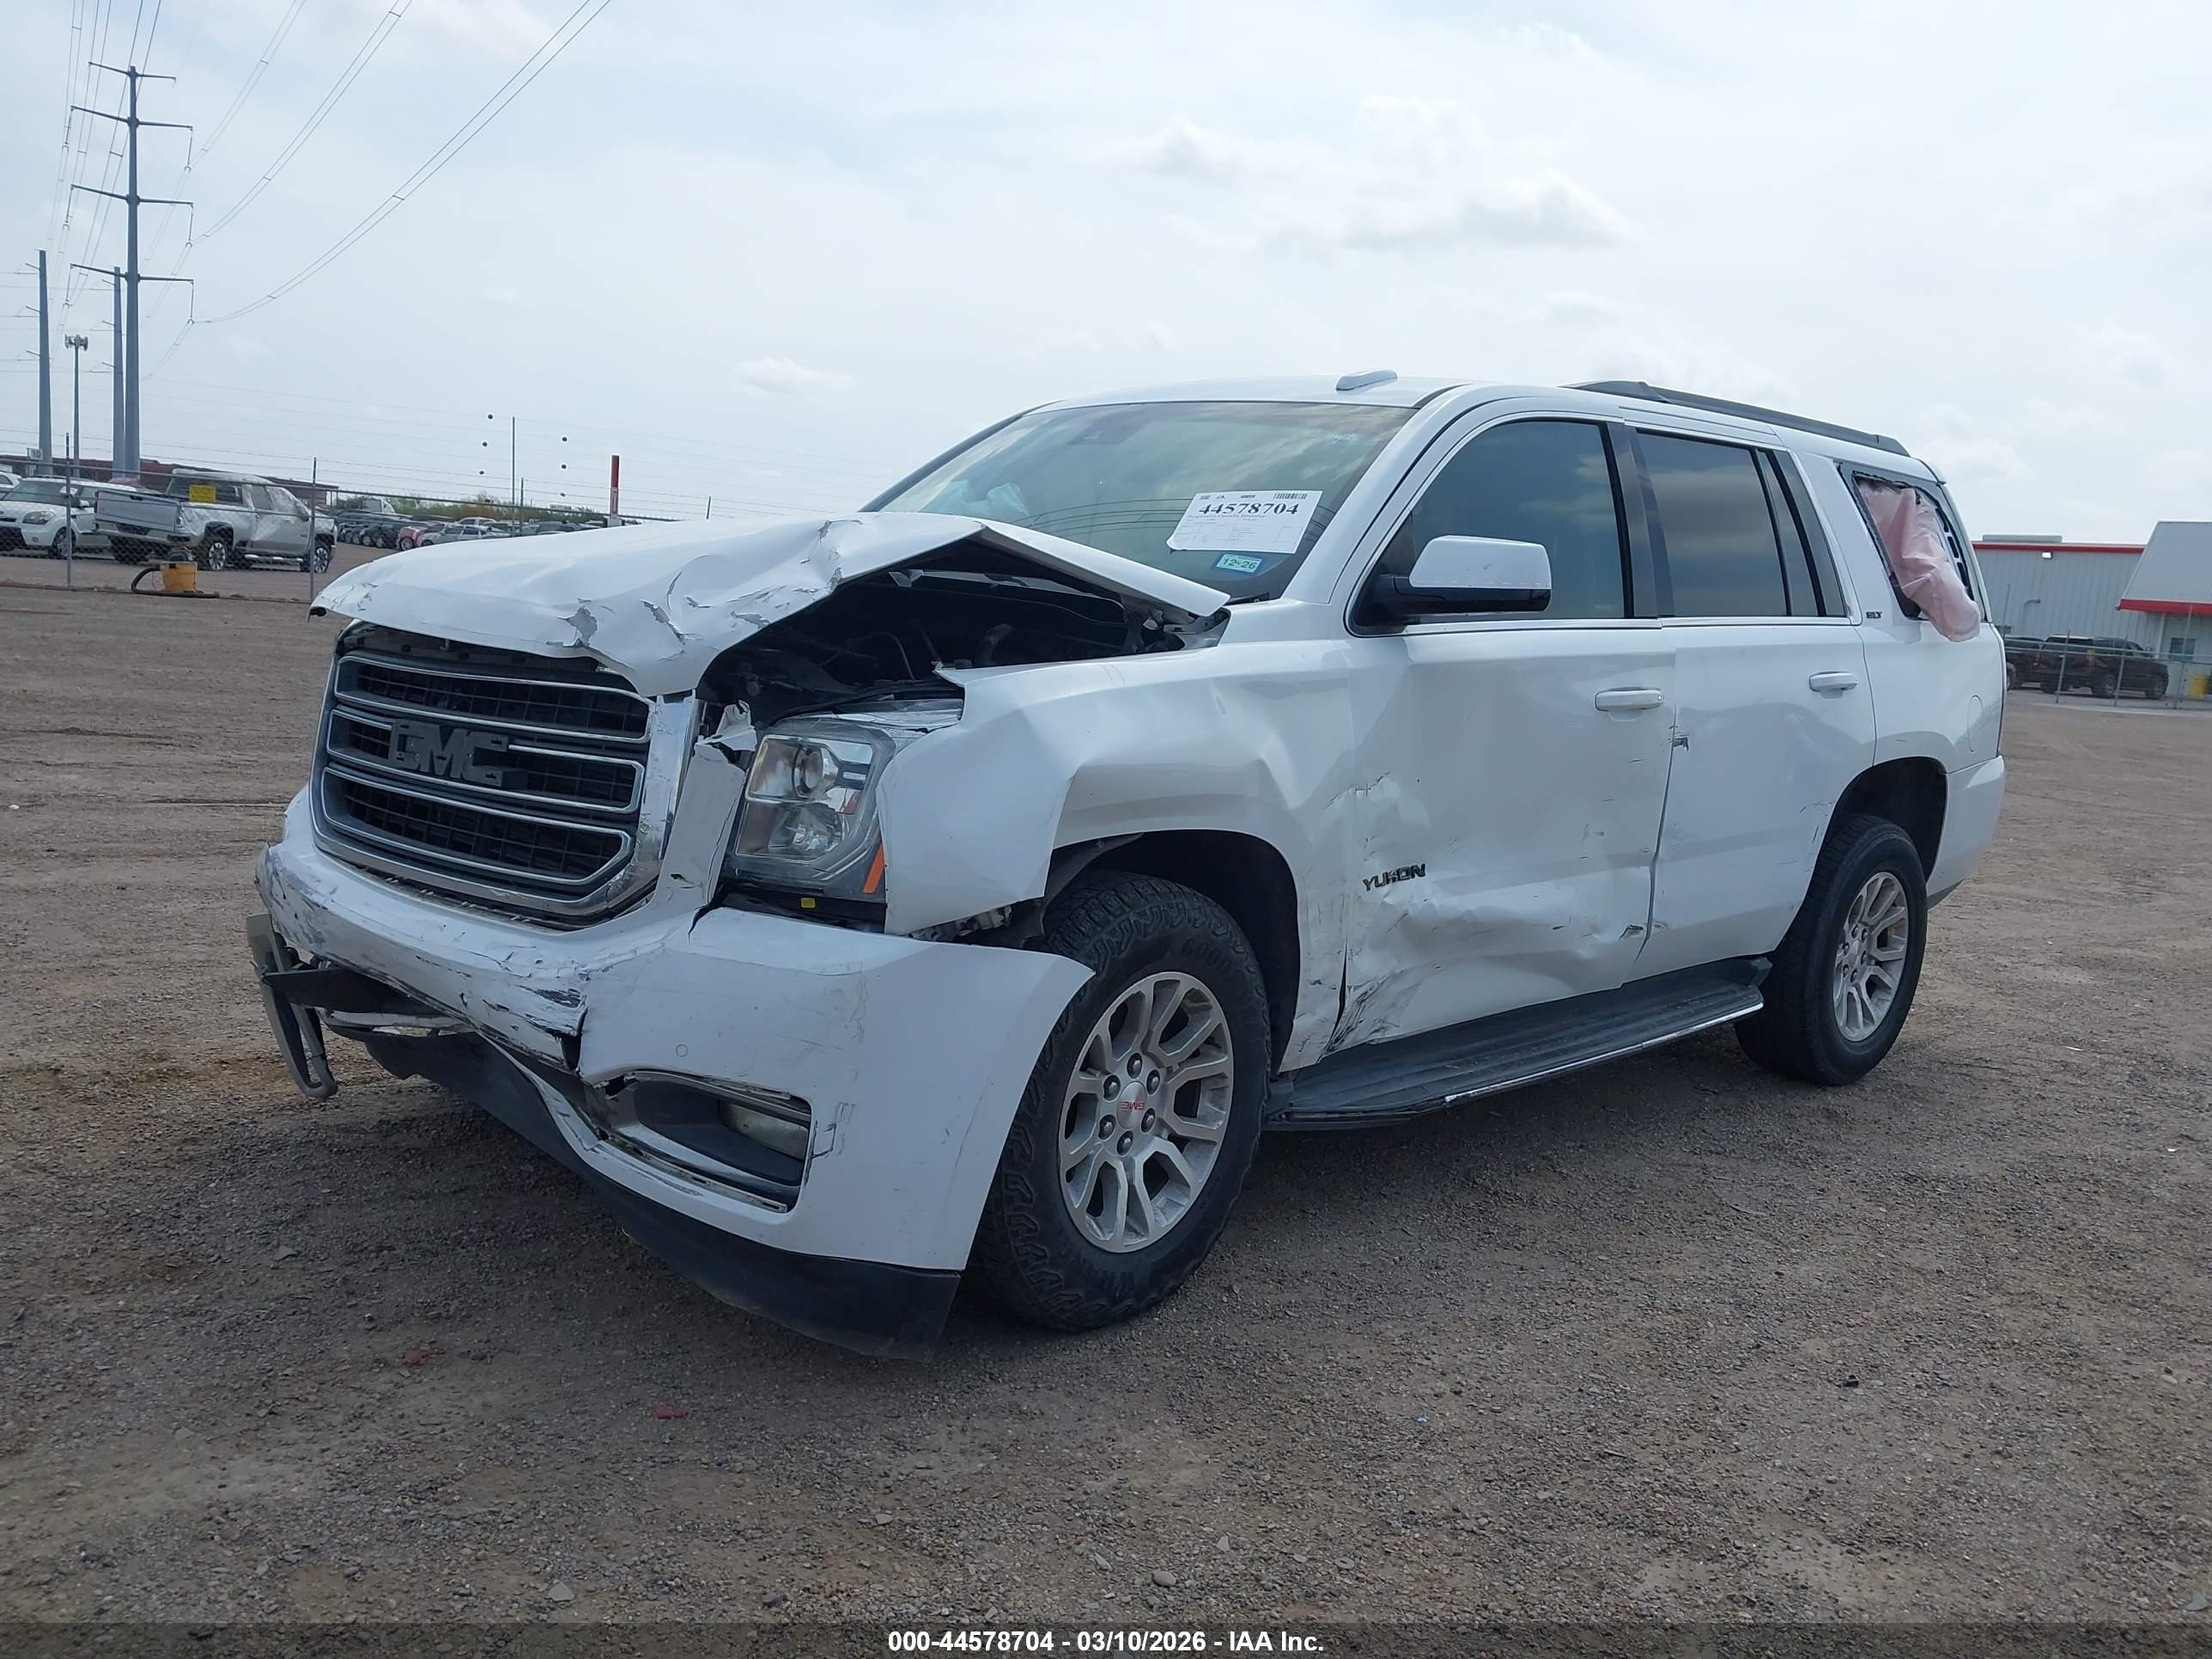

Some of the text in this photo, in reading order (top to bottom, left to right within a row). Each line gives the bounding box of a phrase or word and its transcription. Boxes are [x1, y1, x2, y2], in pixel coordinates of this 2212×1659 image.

[1199, 502, 1299, 514] 44578704
[1223, 558, 1258, 569] 12 26
[1866, 611, 1882, 619] SLT
[389, 719, 508, 787] GMC
[1362, 863, 1426, 892] YUKON
[1119, 1101, 1145, 1110] GMC
